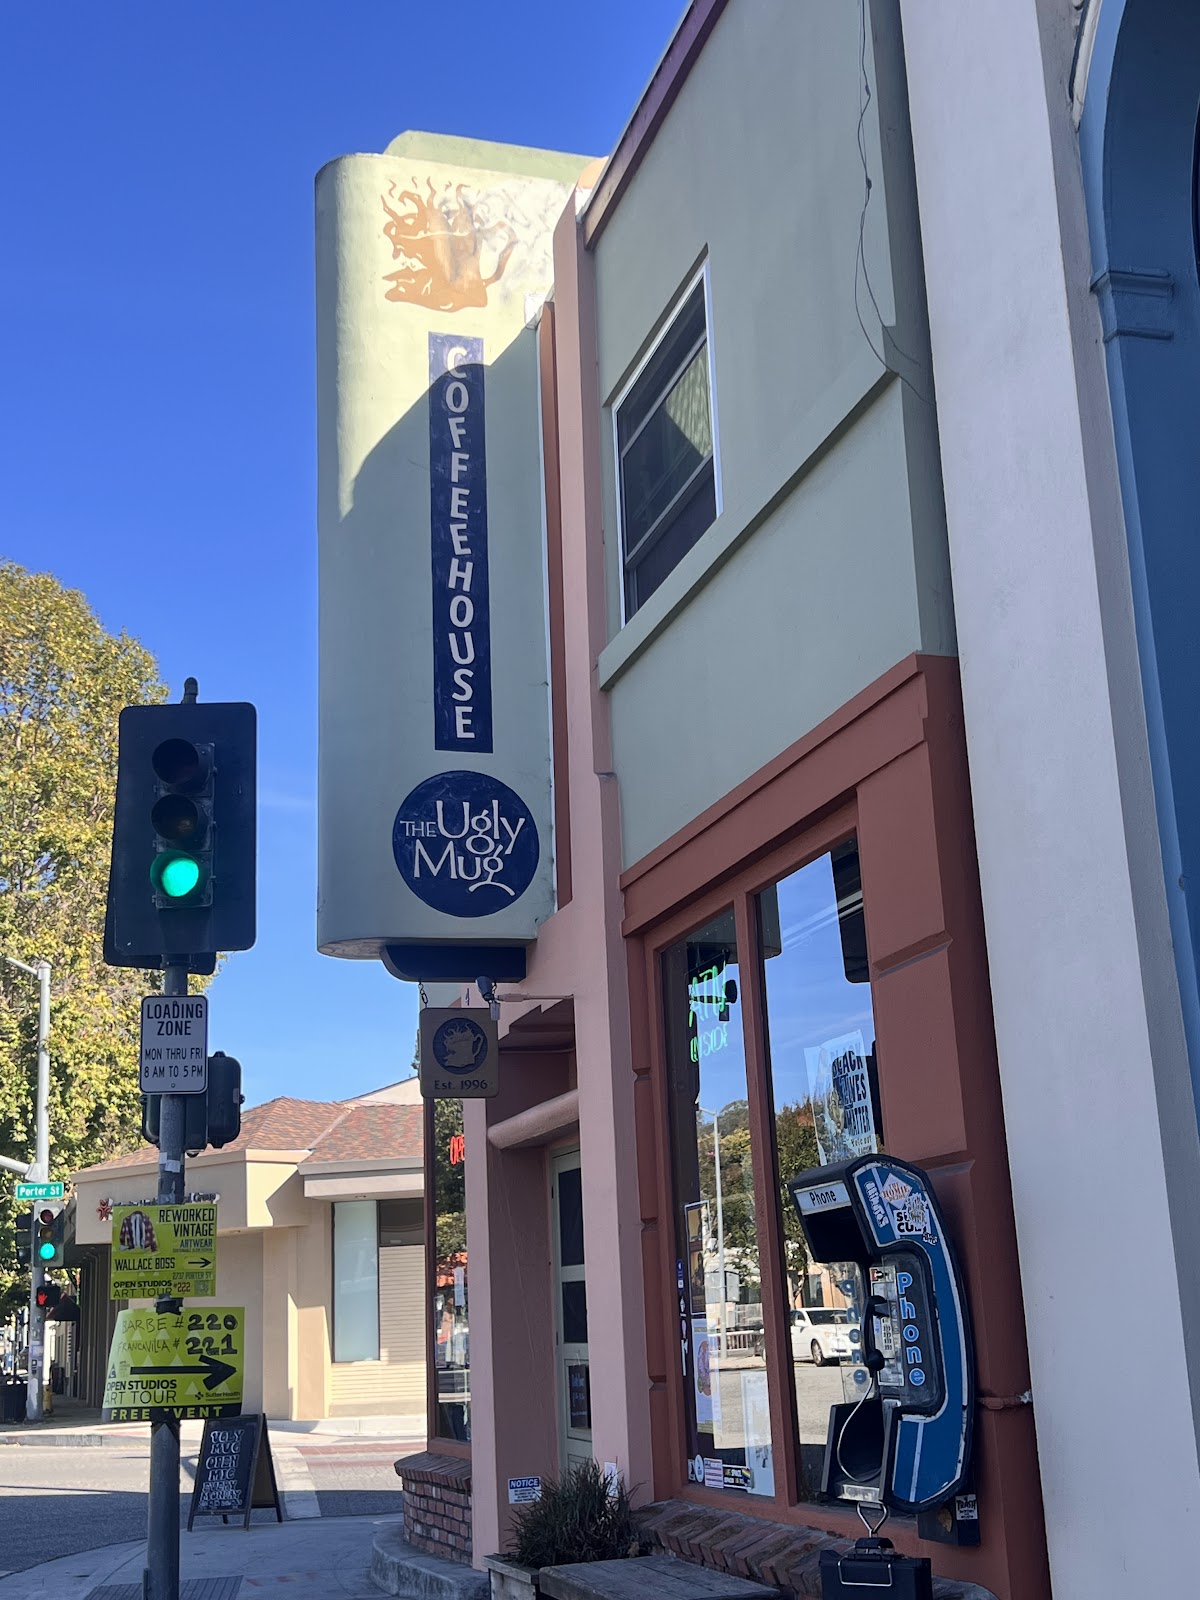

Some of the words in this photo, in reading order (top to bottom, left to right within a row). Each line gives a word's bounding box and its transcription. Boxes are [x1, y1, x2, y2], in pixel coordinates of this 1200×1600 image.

[445, 346, 475, 739] COFFEEHOUSE
[400, 820, 437, 838] THE
[436, 800, 526, 855] Ugly
[413, 838, 516, 897] Mug
[147, 1003, 203, 1019] LOADING
[157, 1020, 192, 1036] ZONE
[145, 1048, 162, 1060] MON
[166, 1048, 187, 1060] THRU
[190, 1047, 203, 1059] FRI
[144, 1066, 149, 1078] 8
[152, 1066, 165, 1078] AM
[169, 1065, 179, 1077] TO
[183, 1065, 189, 1077] 5
[191, 1065, 203, 1077] PM
[434, 1080, 455, 1090] Est.
[461, 1080, 488, 1090] 1996
[20, 1186, 47, 1197] Porter
[50, 1185, 60, 1196] St
[809, 1190, 837, 1206] Phone
[159, 1208, 215, 1223] REWORKED
[173, 1223, 215, 1237] VINTAGE
[180, 1239, 213, 1248] ARTWEAR
[114, 1258, 153, 1271] WALLACE
[155, 1257, 175, 1270] BOSS
[185, 1271, 204, 1279] PORTER
[113, 1281, 136, 1289] OPEN
[137, 1280, 172, 1288] STUDIOS
[113, 1288, 135, 1298] ART
[140, 1287, 172, 1297] TOUR
[122, 1317, 167, 1334] BARBE
[897, 1272, 925, 1386] Phone
[106, 1380, 126, 1391] OPEN
[127, 1379, 177, 1390] STUDIOS
[104, 1391, 126, 1405] ART
[132, 1390, 177, 1404] TOUR
[111, 1409, 150, 1420] FREE
[164, 1406, 223, 1418] VENT
[211, 1442, 240, 1455] MUG
[206, 1454, 240, 1470] OPEN
[208, 1468, 236, 1481] MIC
[510, 1478, 539, 1488] NOTICE
